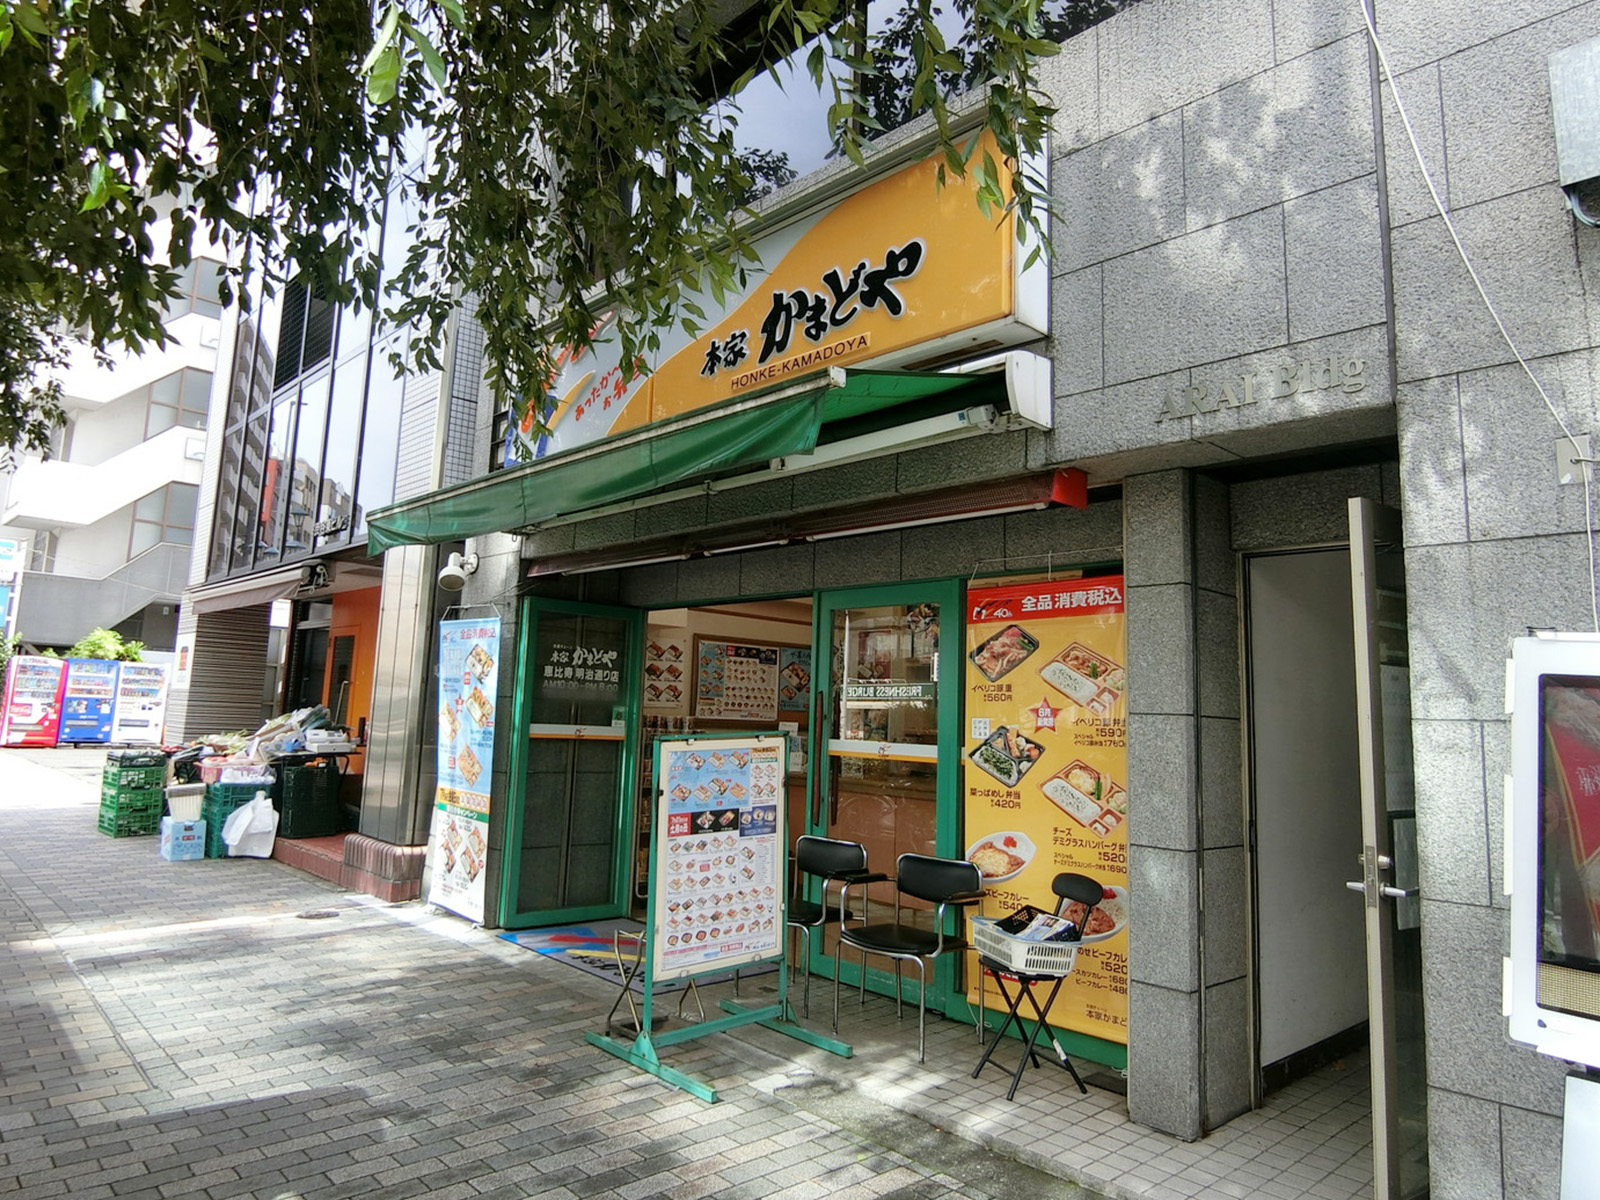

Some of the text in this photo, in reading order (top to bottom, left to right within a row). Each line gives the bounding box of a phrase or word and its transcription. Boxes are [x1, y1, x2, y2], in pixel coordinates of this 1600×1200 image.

[700, 240, 924, 377] 本家 かまどや
[730, 334, 869, 390] HONKE-KAMADOYA
[1154, 357, 1367, 424] ARAI Bldg
[1021, 595, 1053, 612] 全品
[1054, 587, 1122, 609] 消費税込
[550, 645, 618, 668] 本家 かまどや
[543, 665, 619, 682] 恵比寿 明治通り店
[987, 693, 1013, 702] 560円
[994, 800, 1021, 809] 420円
[1053, 827, 1073, 836] チーズ
[1053, 837, 1127, 853] デミグラスハンバーグ弁
[1075, 978, 1108, 989] ビーフカレー
